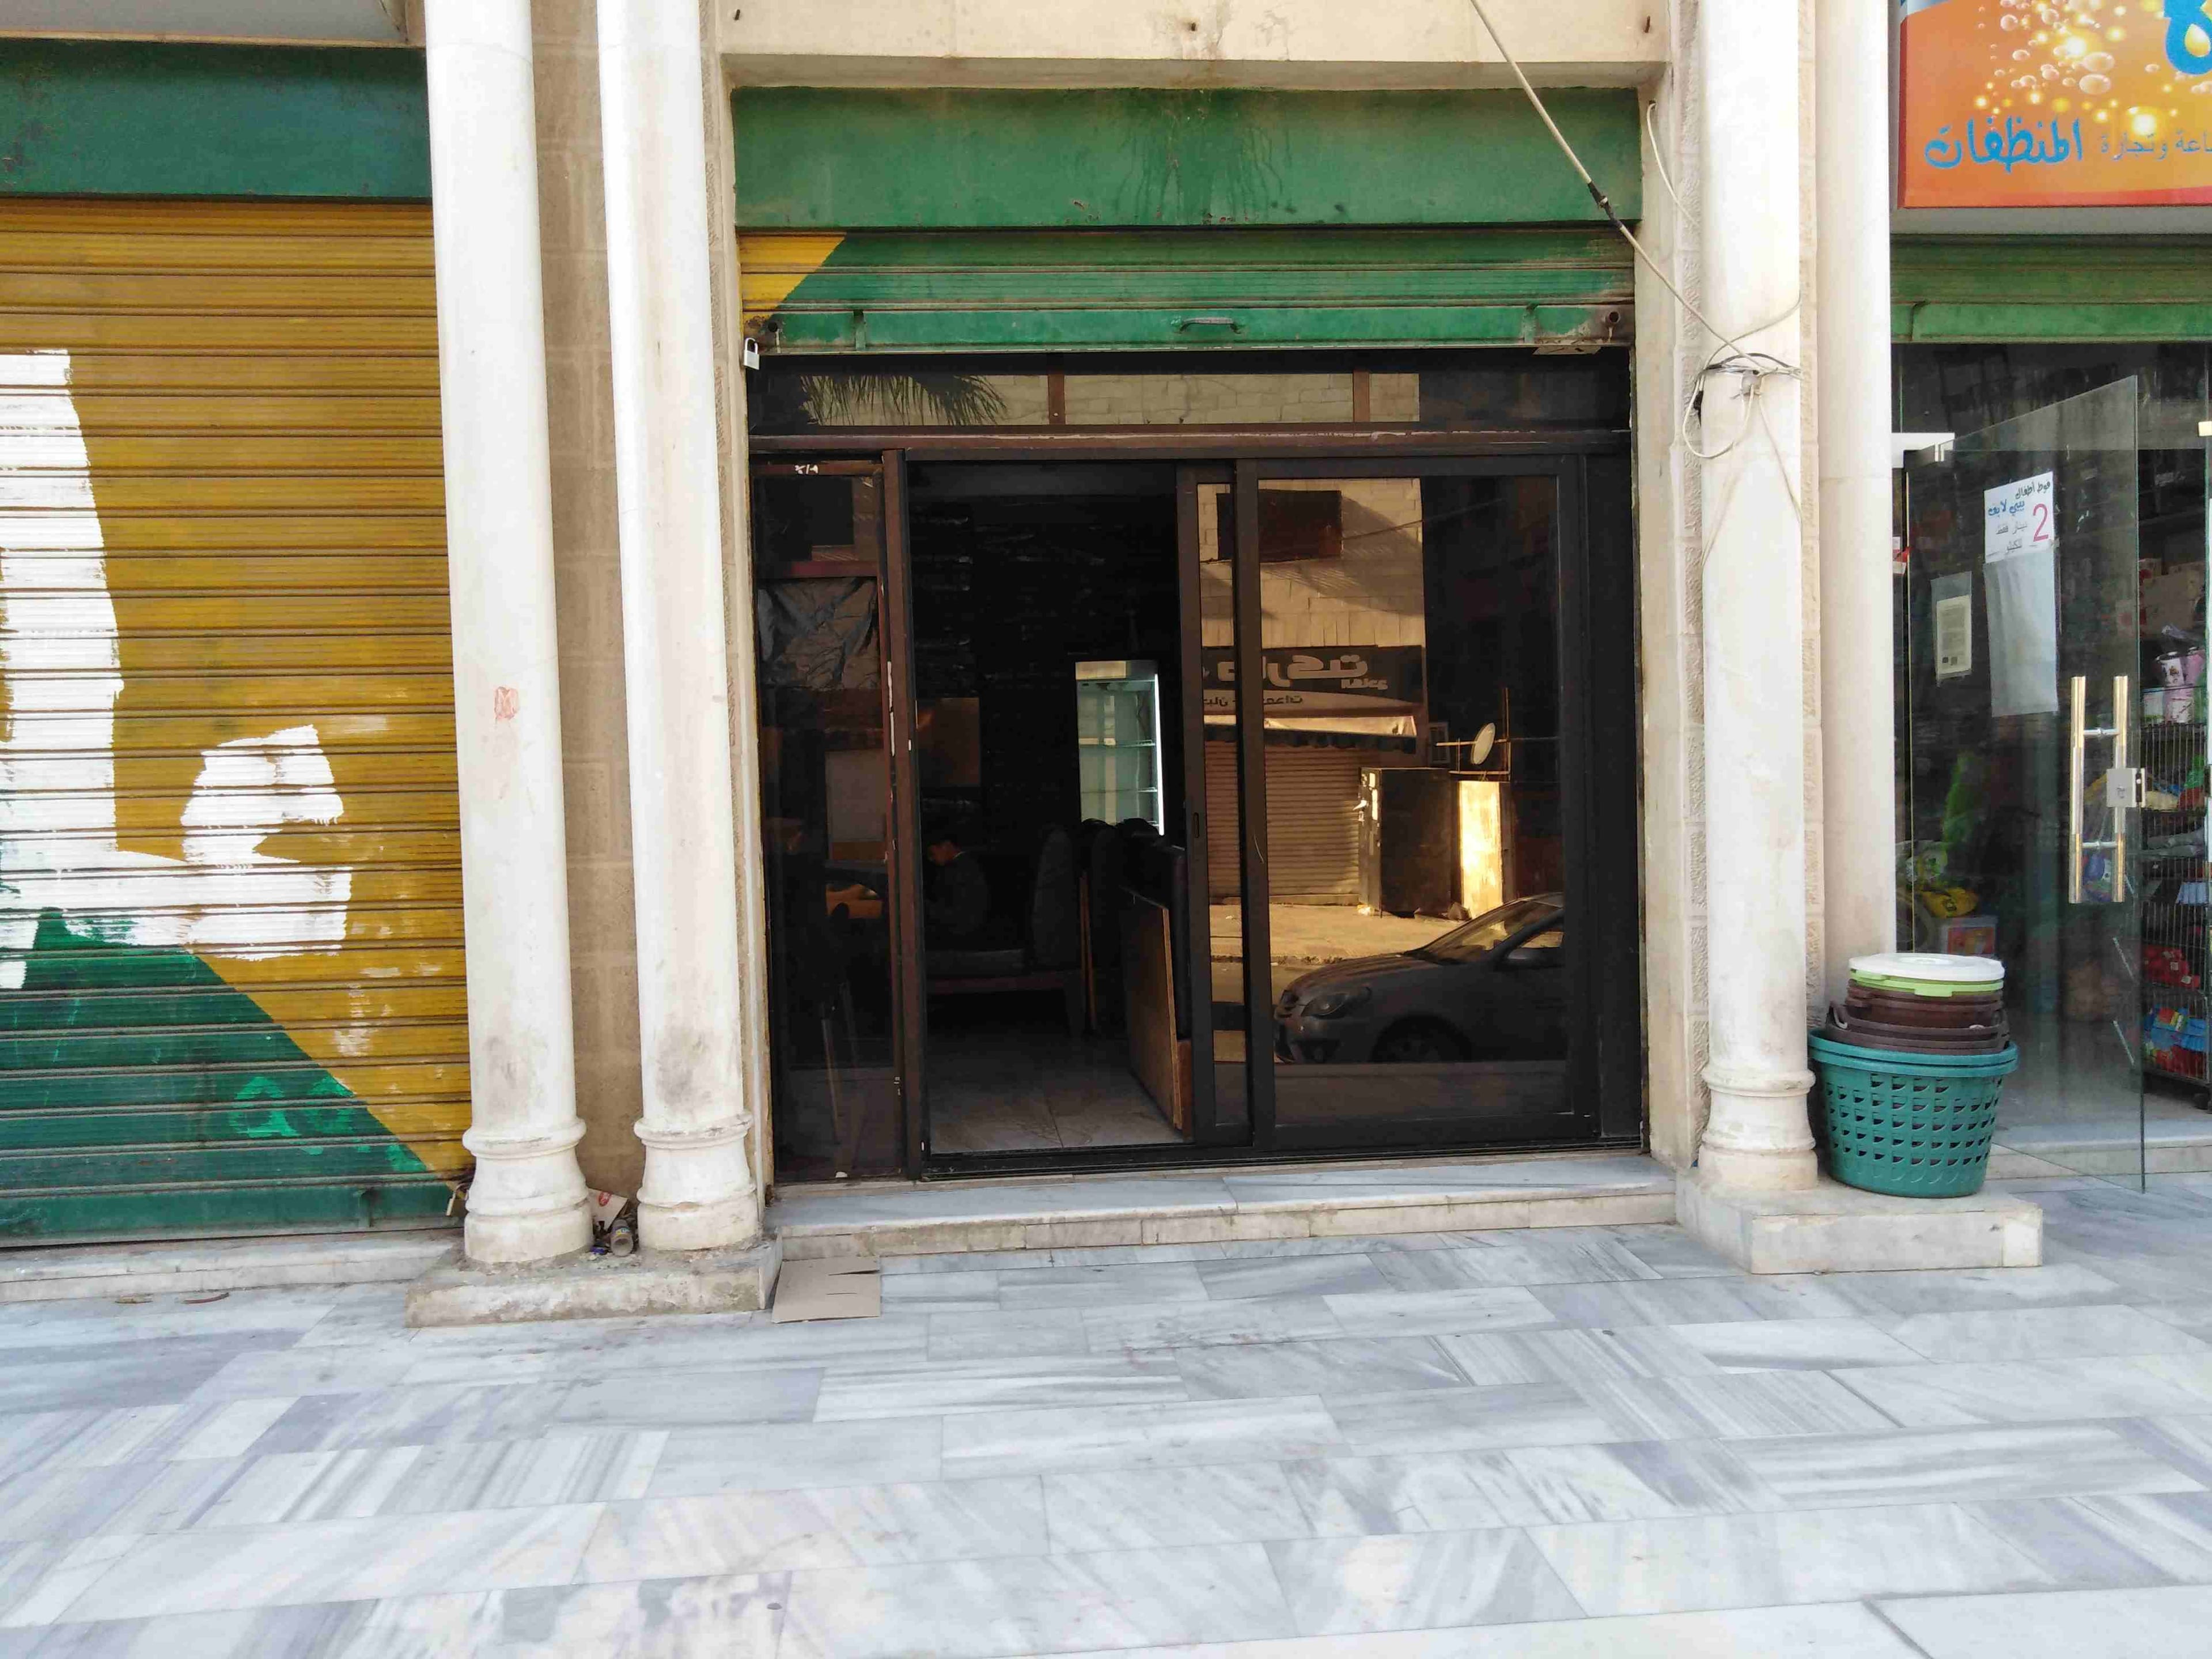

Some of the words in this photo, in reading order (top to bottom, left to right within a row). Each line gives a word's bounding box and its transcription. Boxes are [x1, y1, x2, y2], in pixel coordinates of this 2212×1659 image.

[1924, 116, 2083, 173] المنظفات
[2176, 129, 2212, 153] اعة
[2032, 503, 2048, 542] 2
